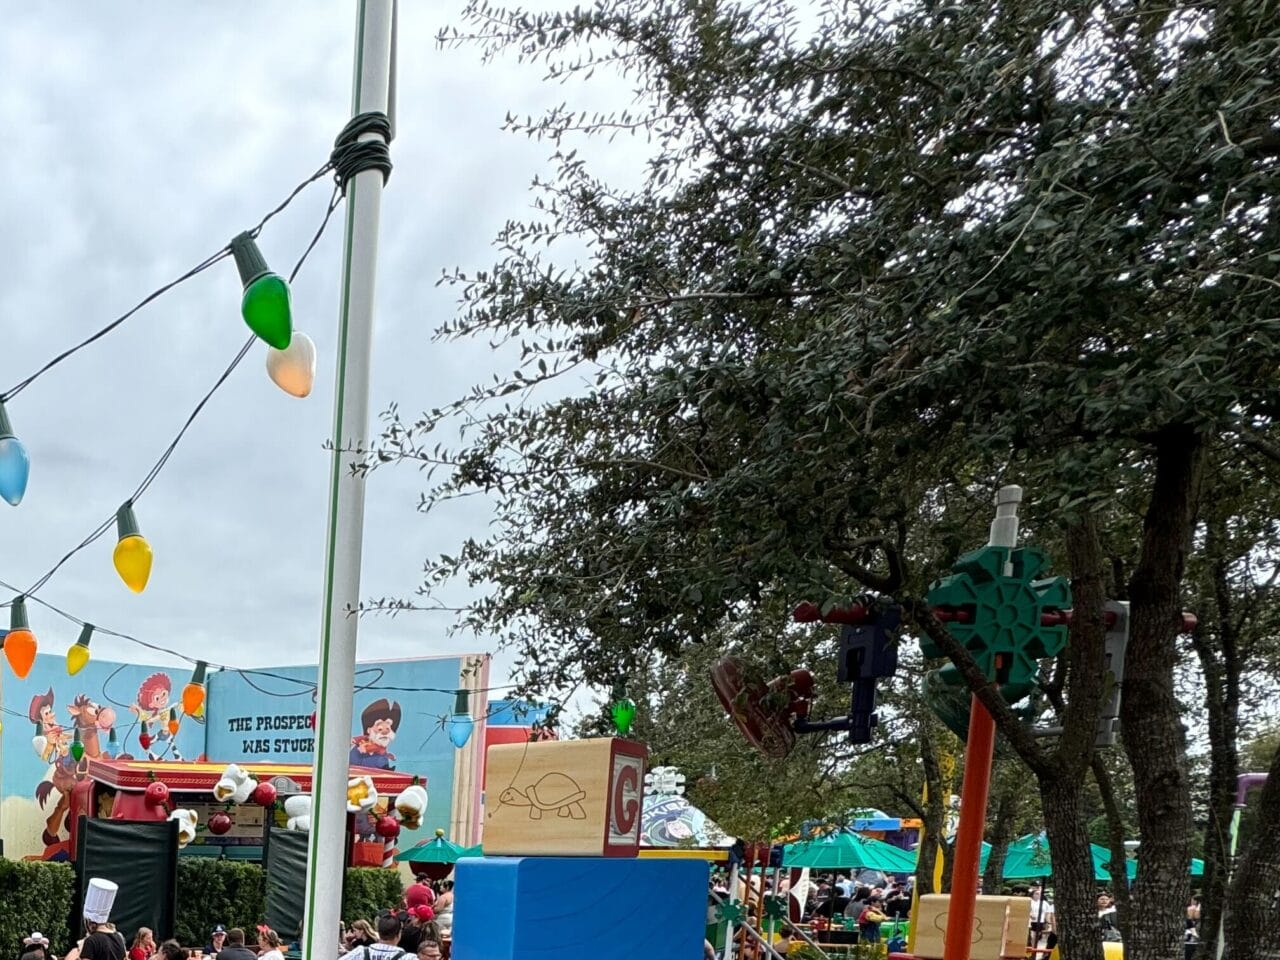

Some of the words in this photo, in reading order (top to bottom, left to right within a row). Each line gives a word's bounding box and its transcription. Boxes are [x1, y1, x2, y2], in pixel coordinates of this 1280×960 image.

[228, 717, 252, 732] THE
[256, 715, 313, 731] PROSPEC
[242, 739, 270, 754] WAS
[273, 738, 315, 753] STUCK
[615, 765, 639, 834] G
